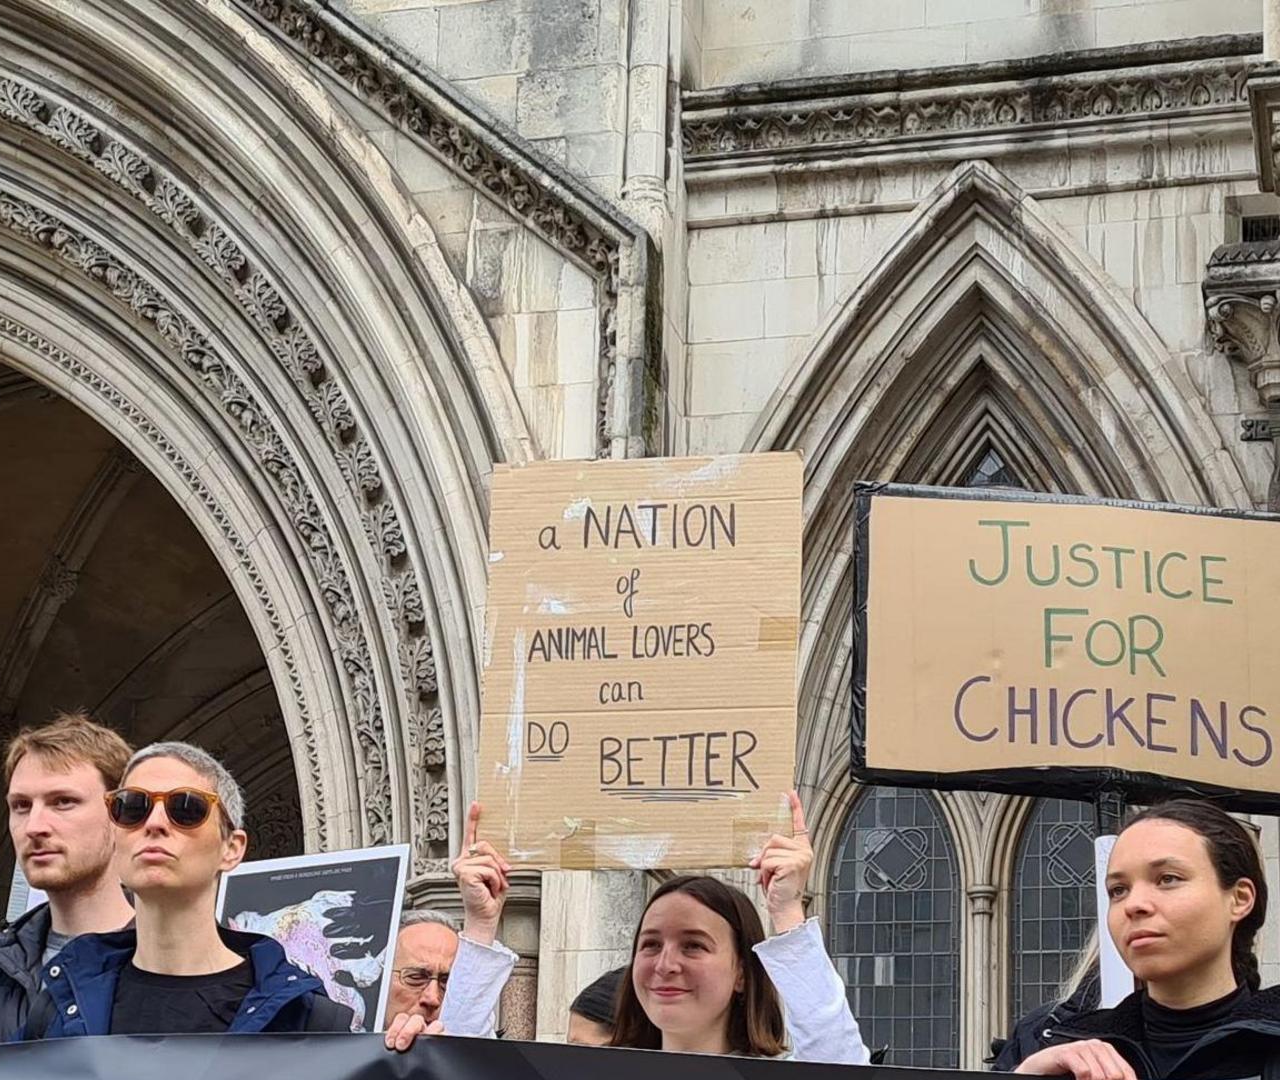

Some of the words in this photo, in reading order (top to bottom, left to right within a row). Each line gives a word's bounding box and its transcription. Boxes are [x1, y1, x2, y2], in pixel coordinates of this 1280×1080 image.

[538, 524, 561, 550] a
[583, 502, 736, 550] NATION
[968, 520, 1234, 605] JUSTICE
[616, 568, 640, 618] of
[527, 626, 619, 662] ANIMAL
[632, 623, 715, 659] LOVERS
[1043, 607, 1167, 677] FOR
[599, 679, 644, 705] can
[527, 721, 569, 754] DO
[954, 675, 1273, 767] CHICKENS
[599, 730, 759, 790] BETTER
